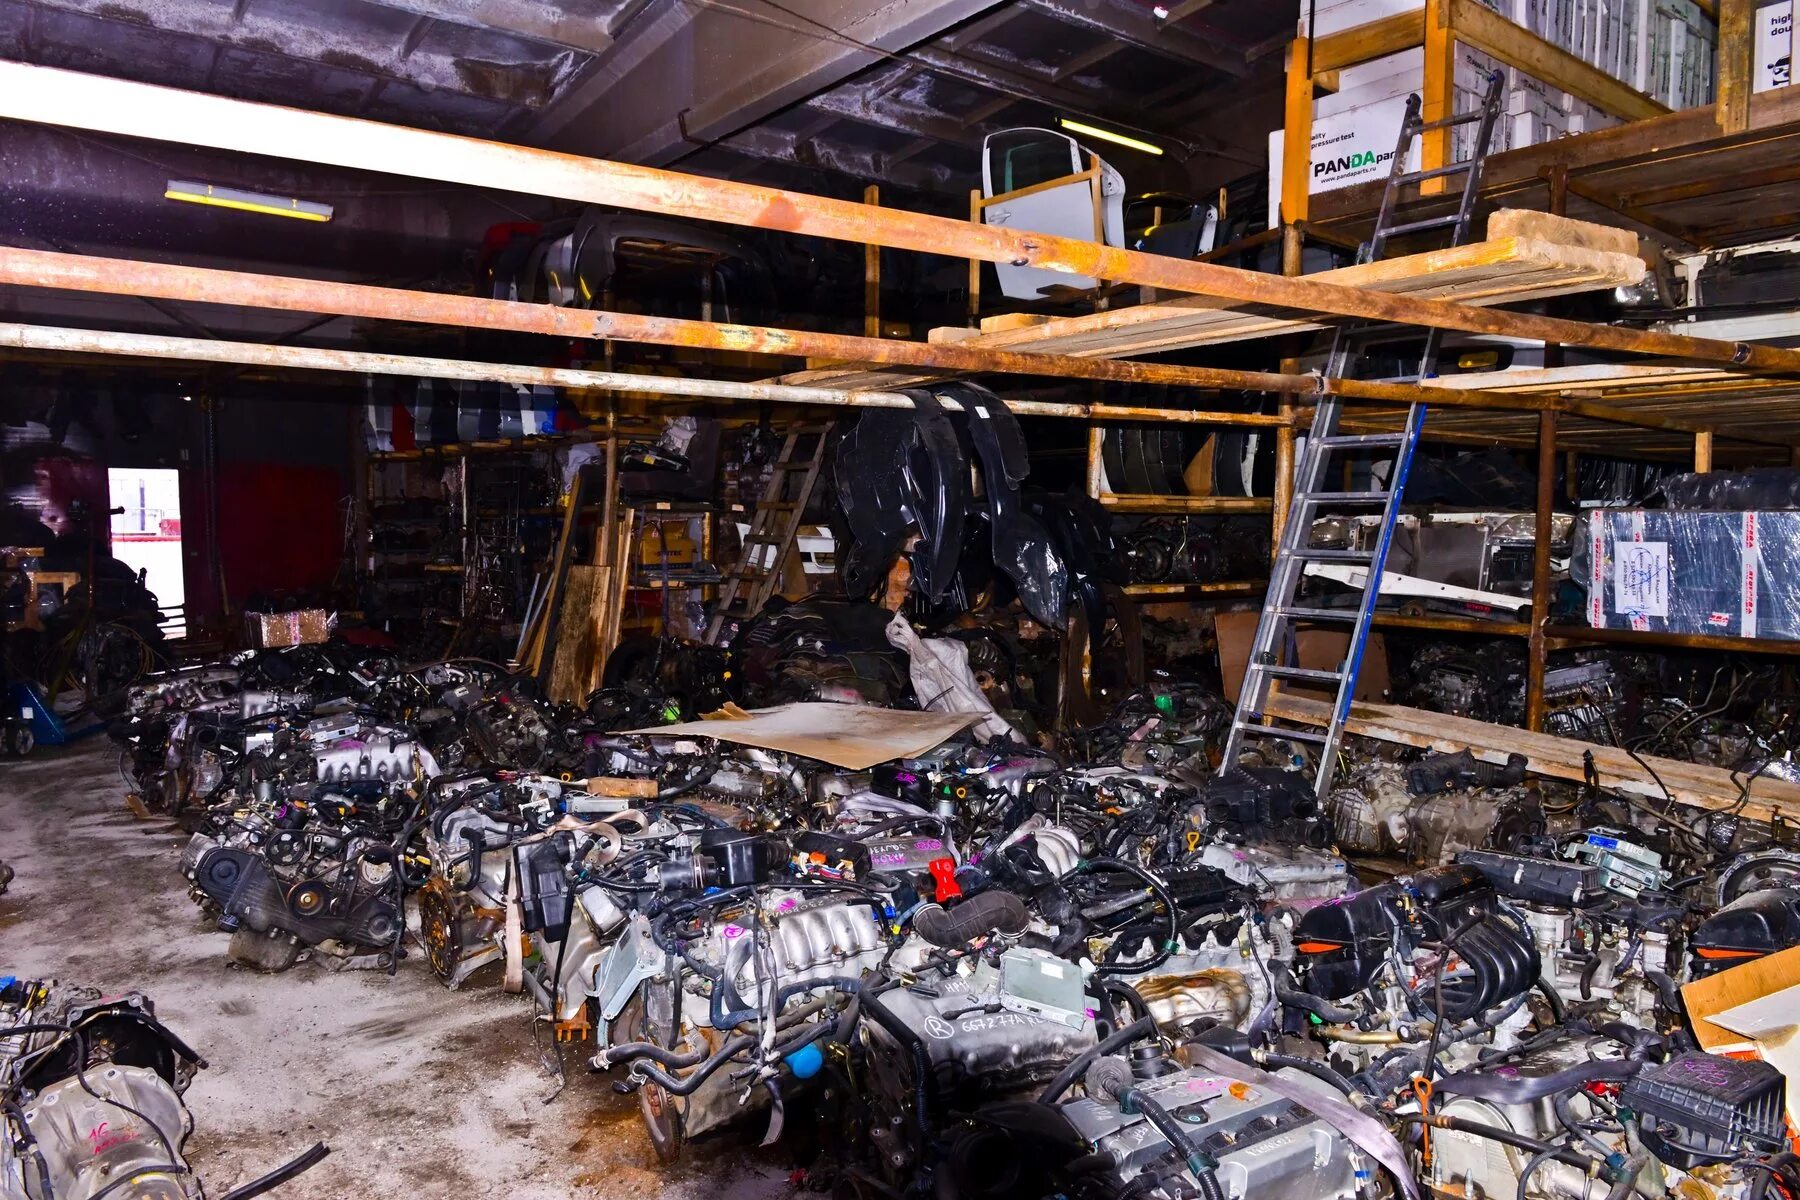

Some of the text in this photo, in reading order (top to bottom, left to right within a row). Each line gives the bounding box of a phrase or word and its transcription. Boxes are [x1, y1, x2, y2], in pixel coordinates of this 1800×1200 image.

[1311, 132, 1355, 150] pressure test
[1320, 166, 1377, 184] www.pandaparts.ru
